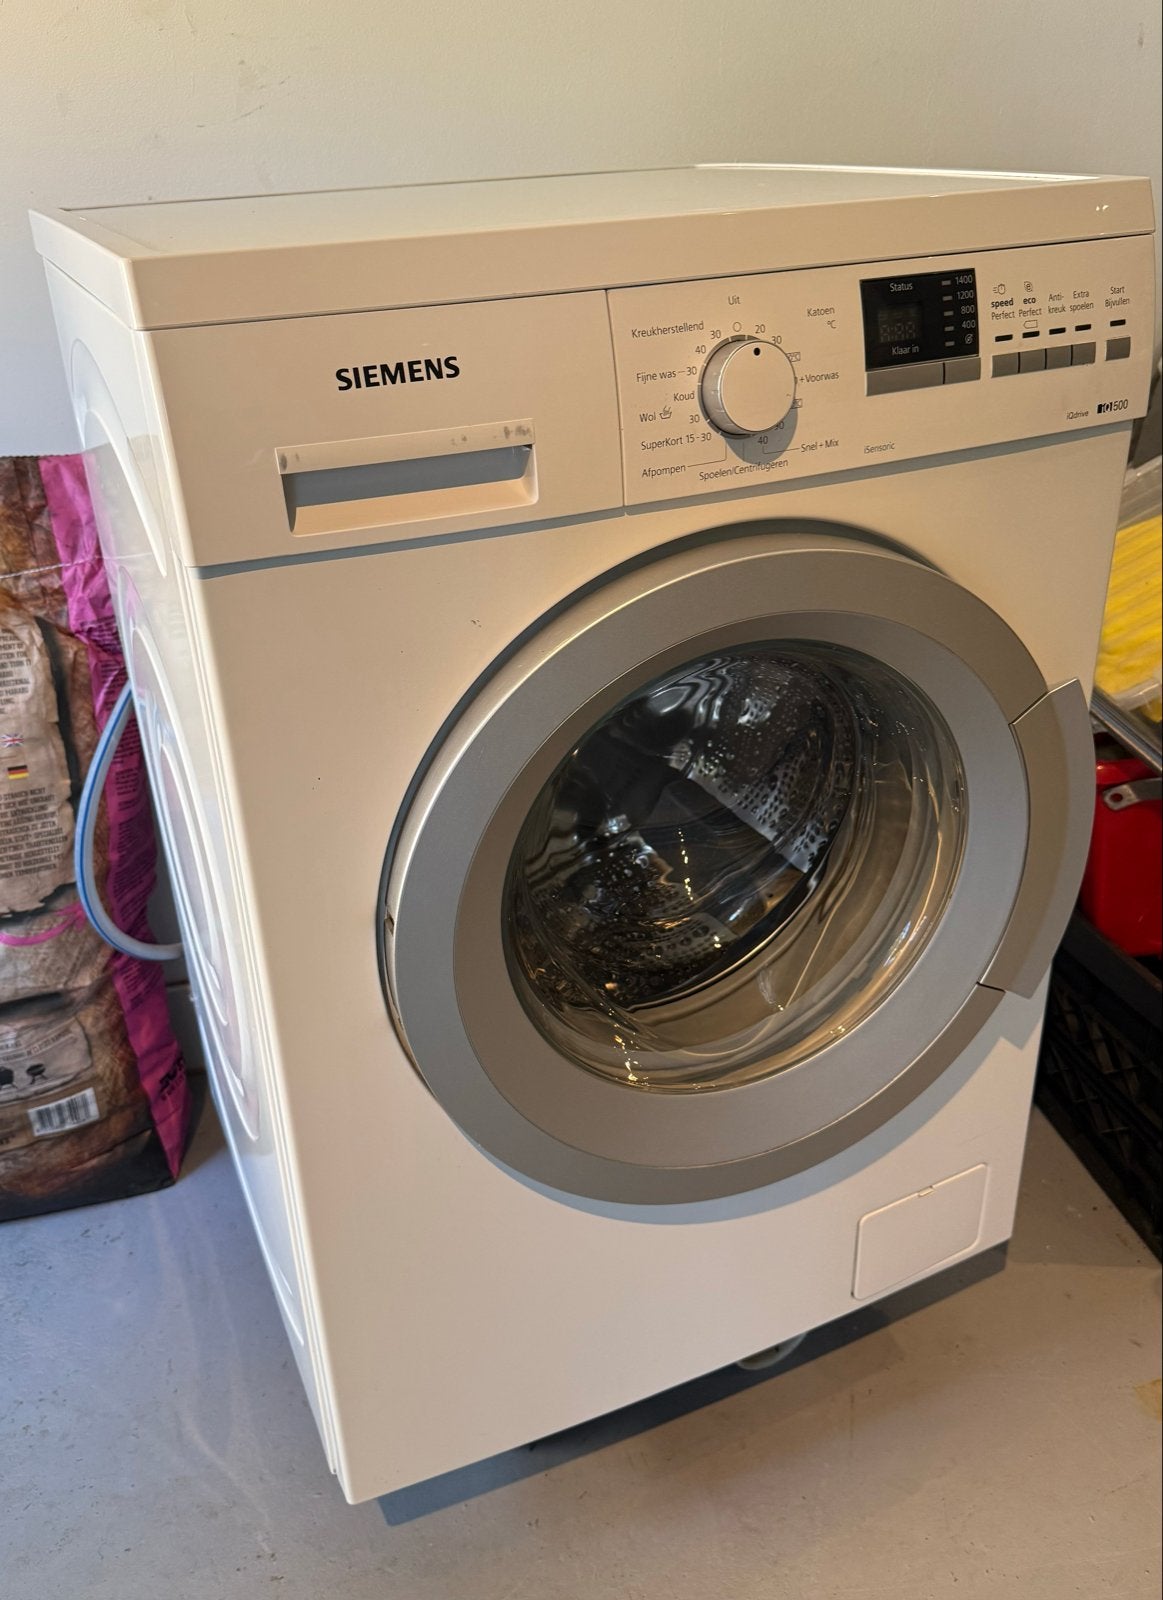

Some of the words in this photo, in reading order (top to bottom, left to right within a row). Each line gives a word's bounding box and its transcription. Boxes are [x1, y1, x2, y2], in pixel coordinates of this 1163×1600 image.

[955, 275, 973, 285] 1400
[889, 282, 913, 292] Status
[1110, 286, 1125, 295] Start
[957, 290, 975, 300] 1200
[1048, 292, 1064, 302] Anti-
[1073, 290, 1090, 299] Extra
[728, 295, 741, 305] Uit
[991, 298, 1014, 309] speed
[1023, 297, 1037, 305] eco
[1105, 297, 1130, 309] Bijvullen
[806, 306, 836, 317] Katoen
[961, 305, 975, 315] 800
[1048, 305, 1066, 314] kreuk
[1070, 301, 1094, 312] spoelen
[991, 310, 1015, 321] Perfect
[1019, 307, 1042, 318] Perfect
[631, 320, 704, 338] Kreukherstellend
[755, 324, 766, 334] 20
[962, 320, 976, 329] 400
[710, 330, 721, 339] 30
[772, 335, 783, 345] 30
[695, 344, 707, 355] 40
[891, 346, 910, 356] Klaar
[912, 344, 920, 354] in
[336, 356, 460, 391] SIEMENS
[686, 366, 697, 376] 30
[636, 371, 658, 384] Fijne
[659, 370, 677, 380] was
[673, 391, 696, 402] Koud
[639, 411, 656, 422] Wol
[689, 414, 700, 424] 30
[641, 436, 684, 451] SuperKort
[757, 435, 769, 445] 40
[801, 442, 817, 453] Snel
[825, 439, 839, 449] Mix
[641, 464, 686, 478] Afpompen
